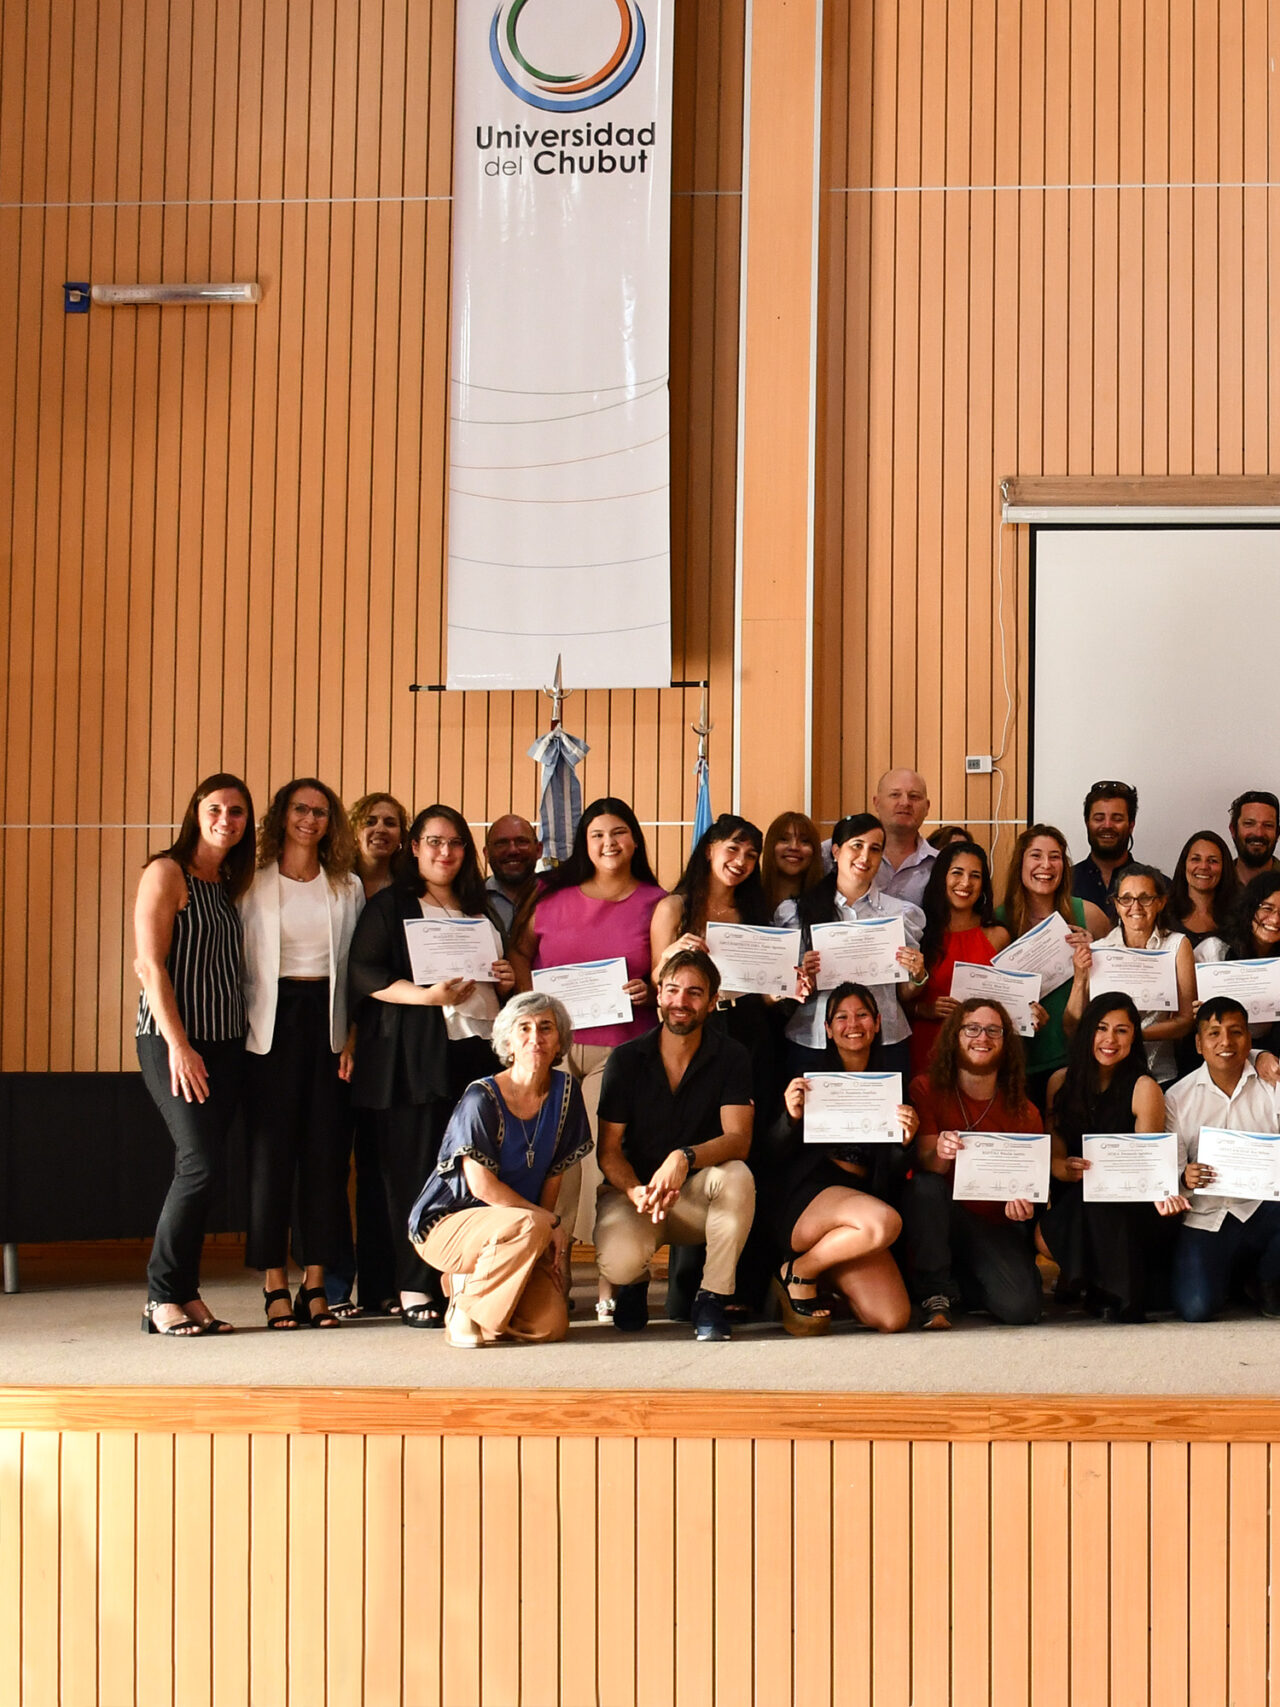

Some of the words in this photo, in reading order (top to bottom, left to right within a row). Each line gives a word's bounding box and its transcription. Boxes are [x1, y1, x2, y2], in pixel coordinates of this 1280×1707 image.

[476, 122, 656, 150] Universidad
[484, 156, 523, 177] del
[533, 149, 648, 175] Chubut
